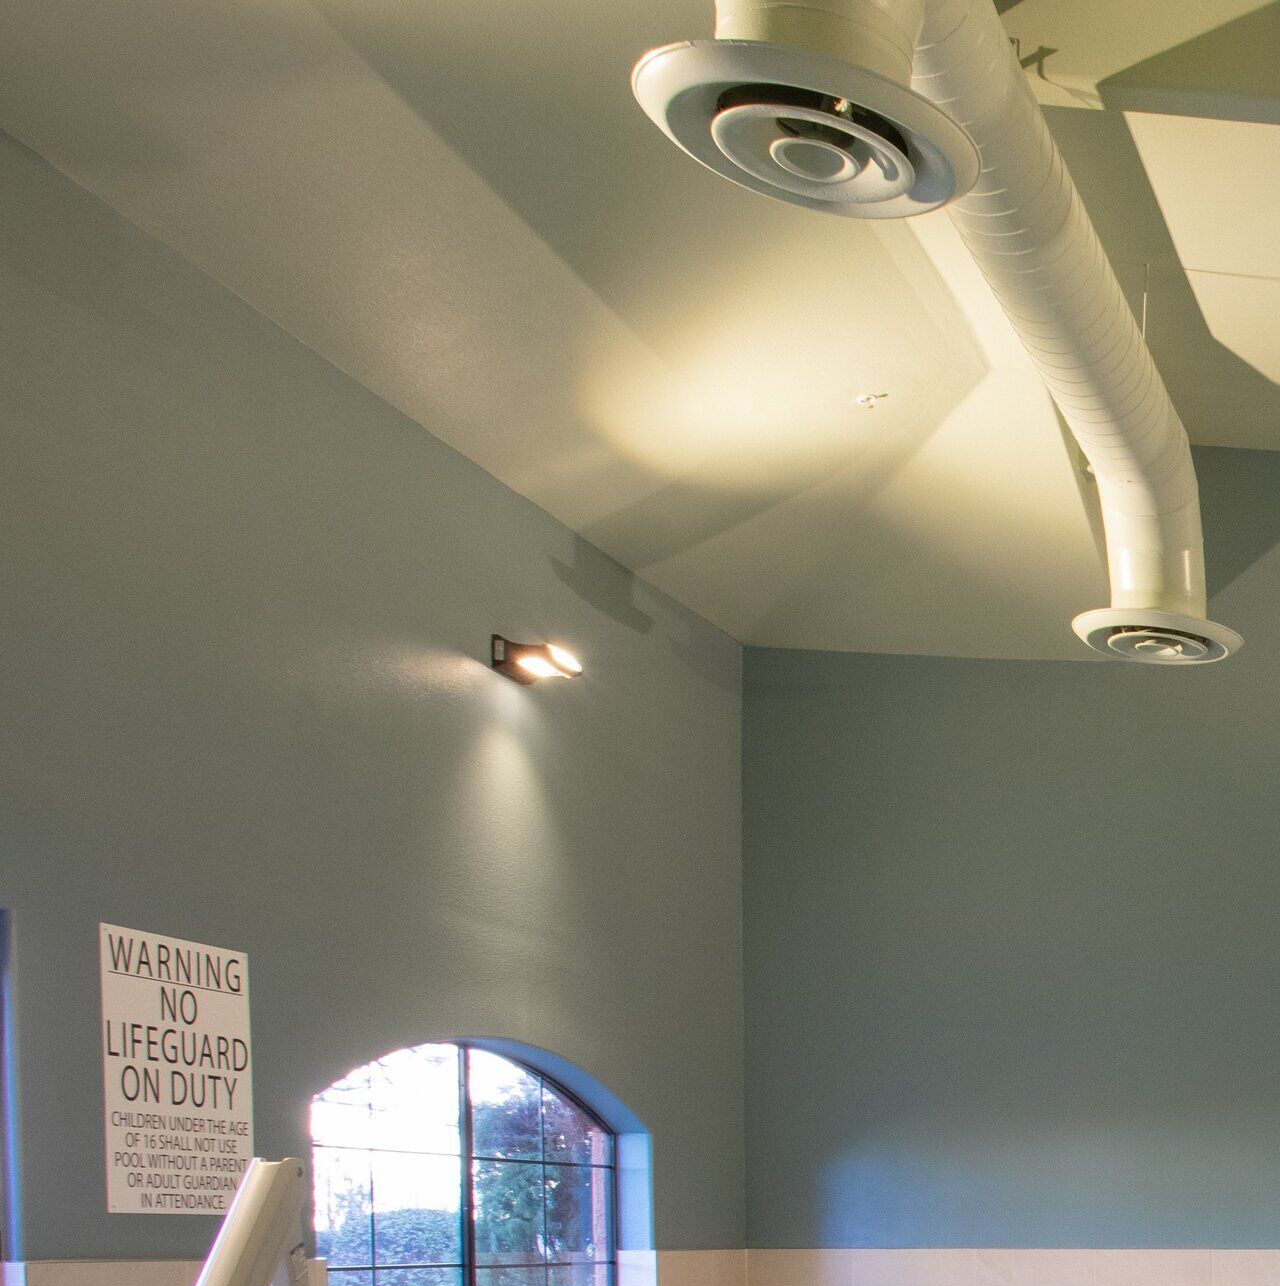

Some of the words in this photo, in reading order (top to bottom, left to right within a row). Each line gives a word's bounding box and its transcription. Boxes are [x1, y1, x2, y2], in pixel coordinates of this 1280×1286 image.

[108, 933, 242, 993] WARNING
[160, 986, 198, 1026] NO
[107, 1019, 249, 1073] LIFEGUARD
[120, 1064, 160, 1105] ON
[171, 1070, 238, 1111] DUTY
[111, 1110, 168, 1131] CHILDREN
[168, 1116, 205, 1134] UNDER
[206, 1119, 227, 1135] THE
[229, 1120, 249, 1137] AGE
[125, 1132, 141, 1149] OF
[144, 1134, 157, 1150] 16
[159, 1135, 192, 1152] SHALL
[194, 1138, 217, 1153] NOT
[218, 1139, 238, 1154] USE
[115, 1151, 146, 1169] POOL
[148, 1153, 199, 1171] WITHOUT
[200, 1156, 209, 1171] A
[209, 1157, 247, 1173] PARENT
[127, 1172, 144, 1188] OR
[146, 1173, 182, 1190] ADULT
[182, 1174, 237, 1191] GUARDIAN
[141, 1192, 153, 1208] IN
[155, 1193, 227, 1210] ATTENDANCE.
